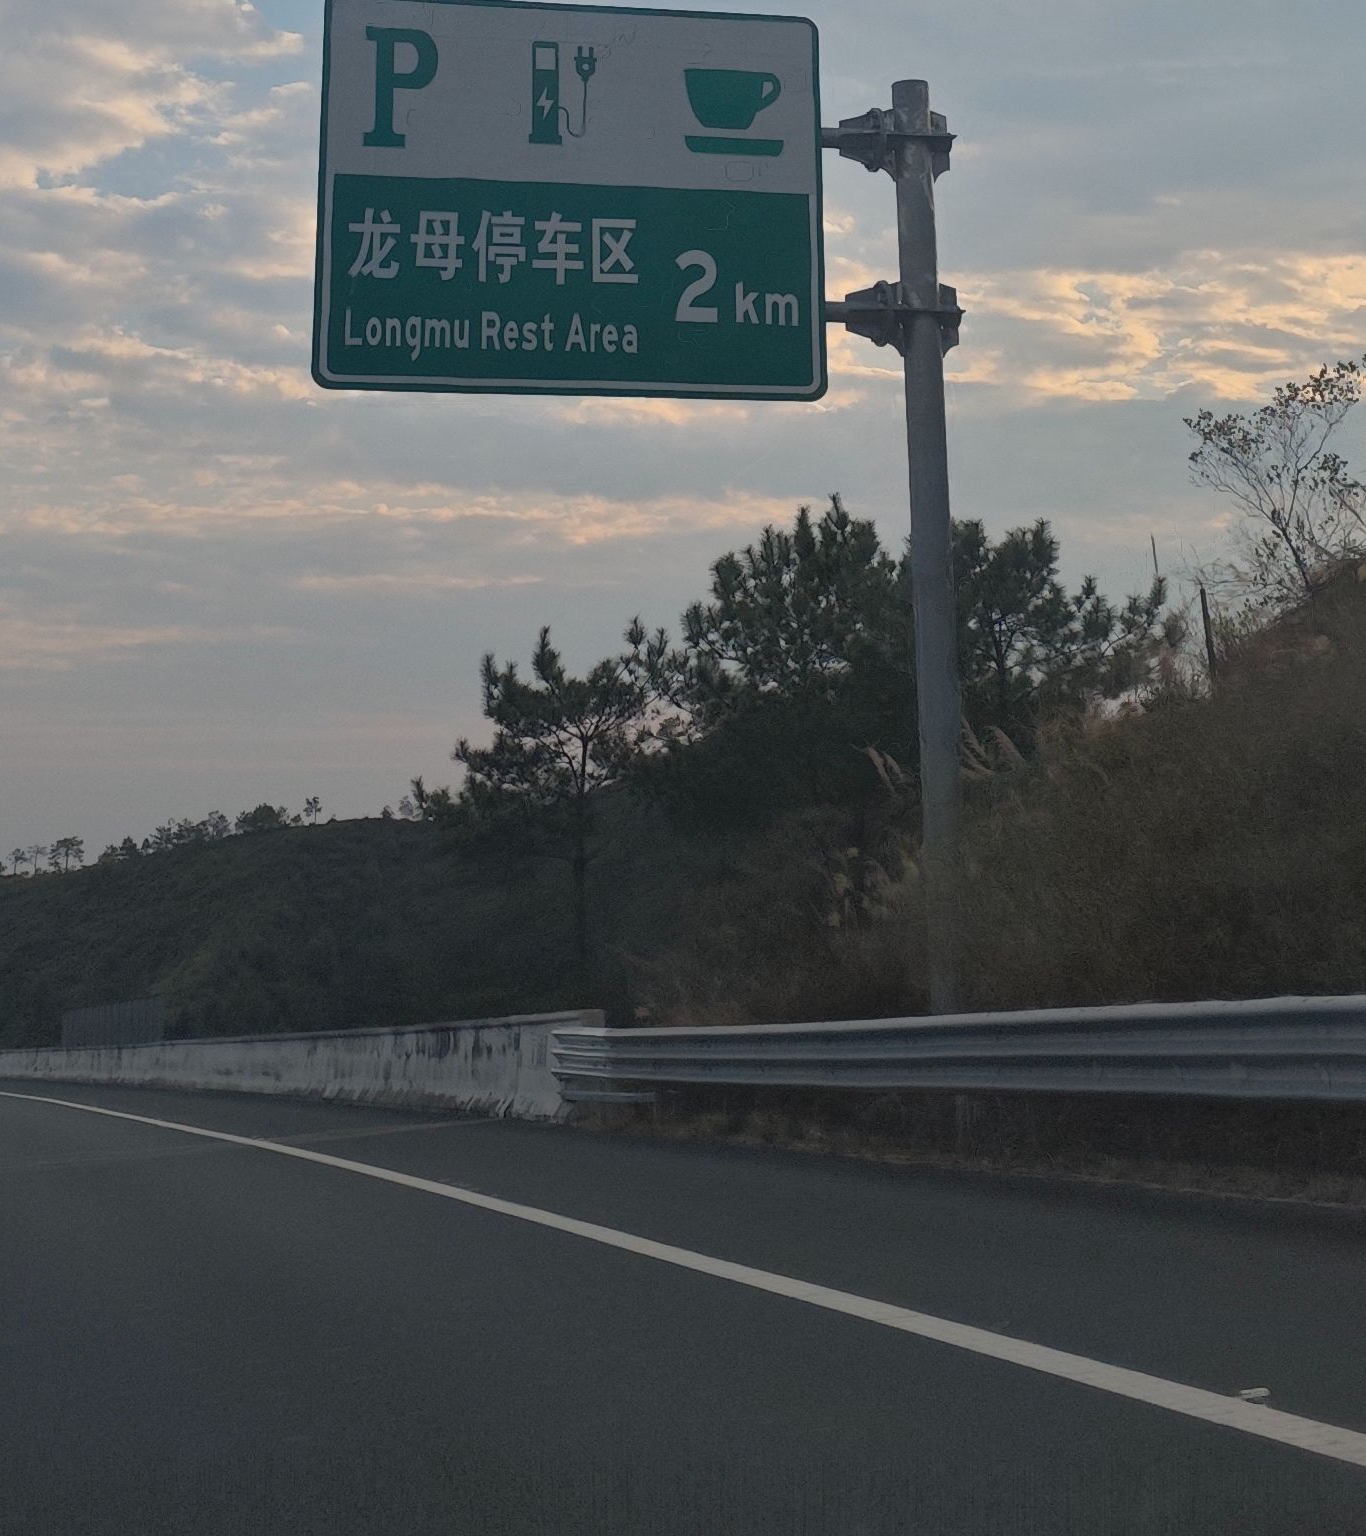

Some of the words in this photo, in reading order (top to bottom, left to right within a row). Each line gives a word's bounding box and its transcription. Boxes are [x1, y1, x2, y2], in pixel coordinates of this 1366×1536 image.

[363, 25, 439, 148] P
[347, 207, 639, 285] 龙母停车区
[674, 249, 718, 323] 2
[735, 281, 800, 327] km
[344, 307, 470, 362] Longmu
[481, 311, 555, 351] Rest
[564, 312, 639, 354] Area
